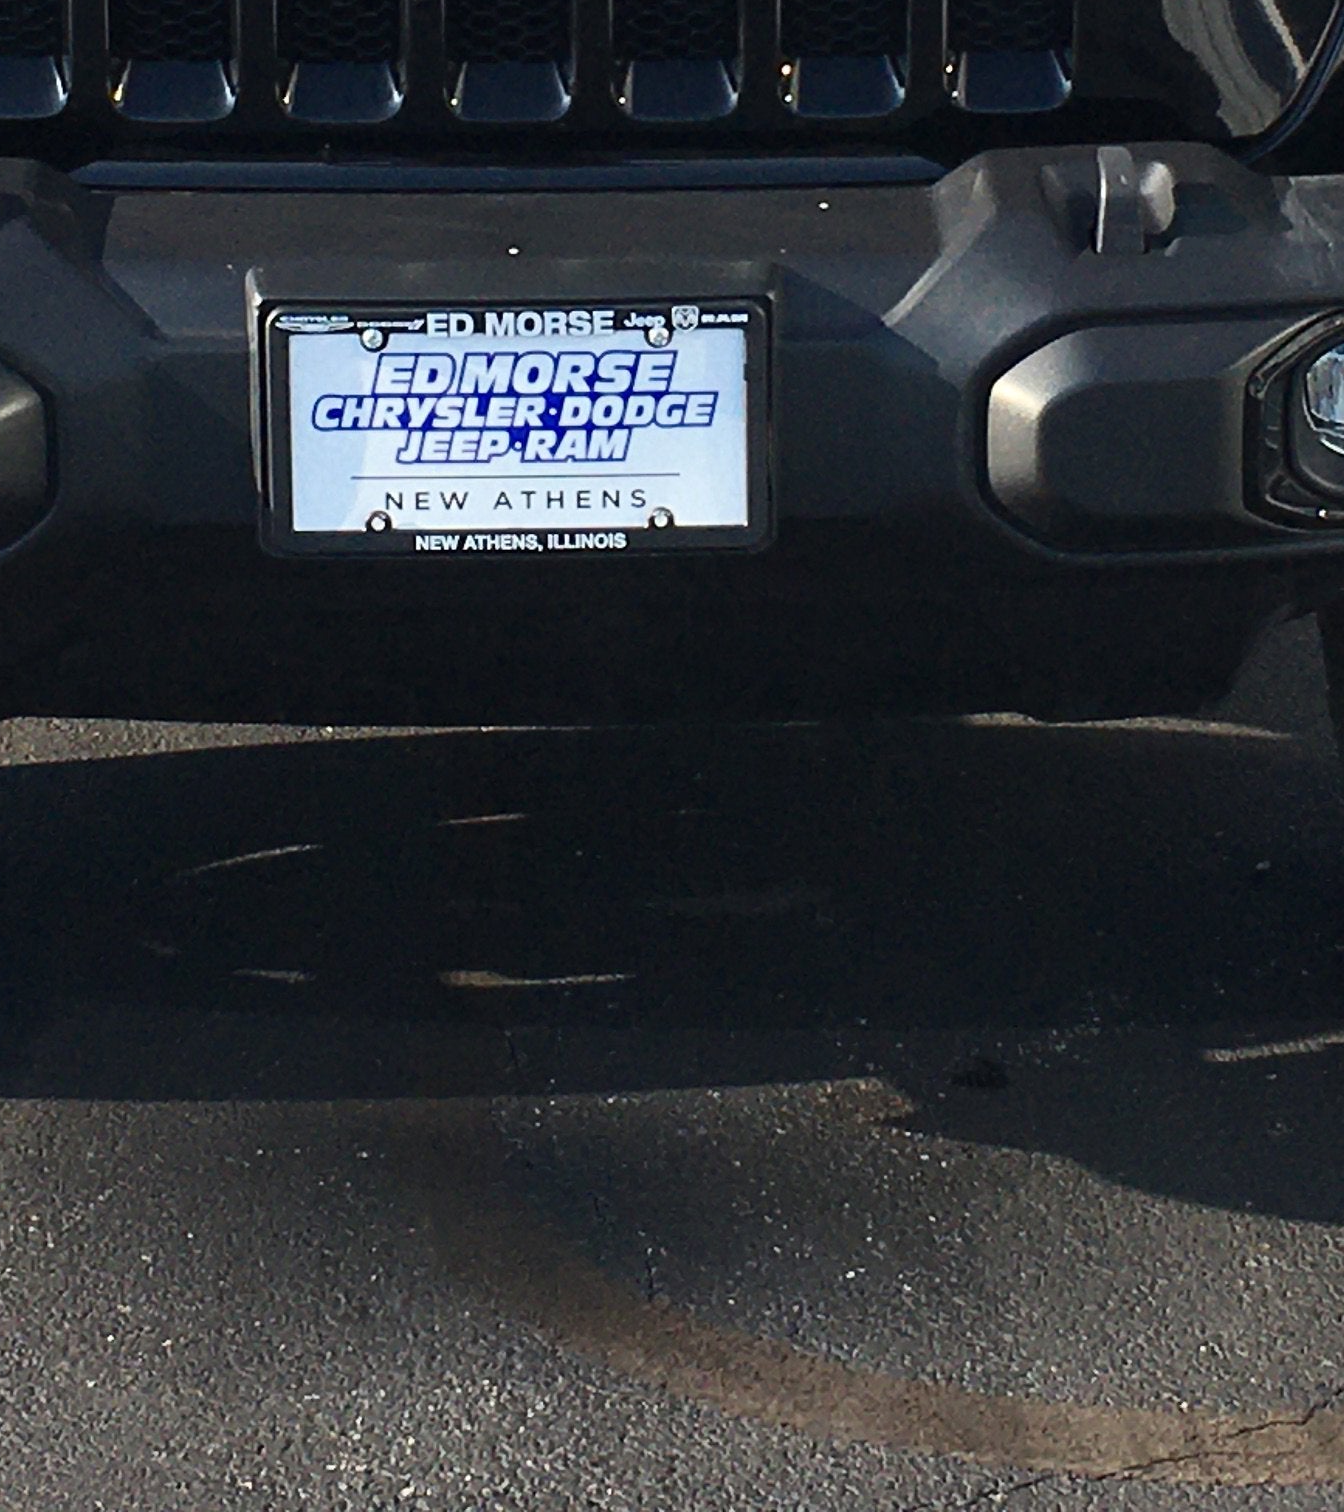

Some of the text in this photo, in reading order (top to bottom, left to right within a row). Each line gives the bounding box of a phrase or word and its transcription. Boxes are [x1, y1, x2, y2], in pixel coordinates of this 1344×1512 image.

[426, 310, 614, 338] ED MORSE
[371, 349, 678, 395] ED MORSE
[312, 391, 719, 431] CHRYSLER DODGE
[395, 427, 632, 464] JEEP RAM
[385, 488, 647, 511] NEW ATHENS
[415, 532, 628, 552] NEW ATHENS, ILLINOIS
